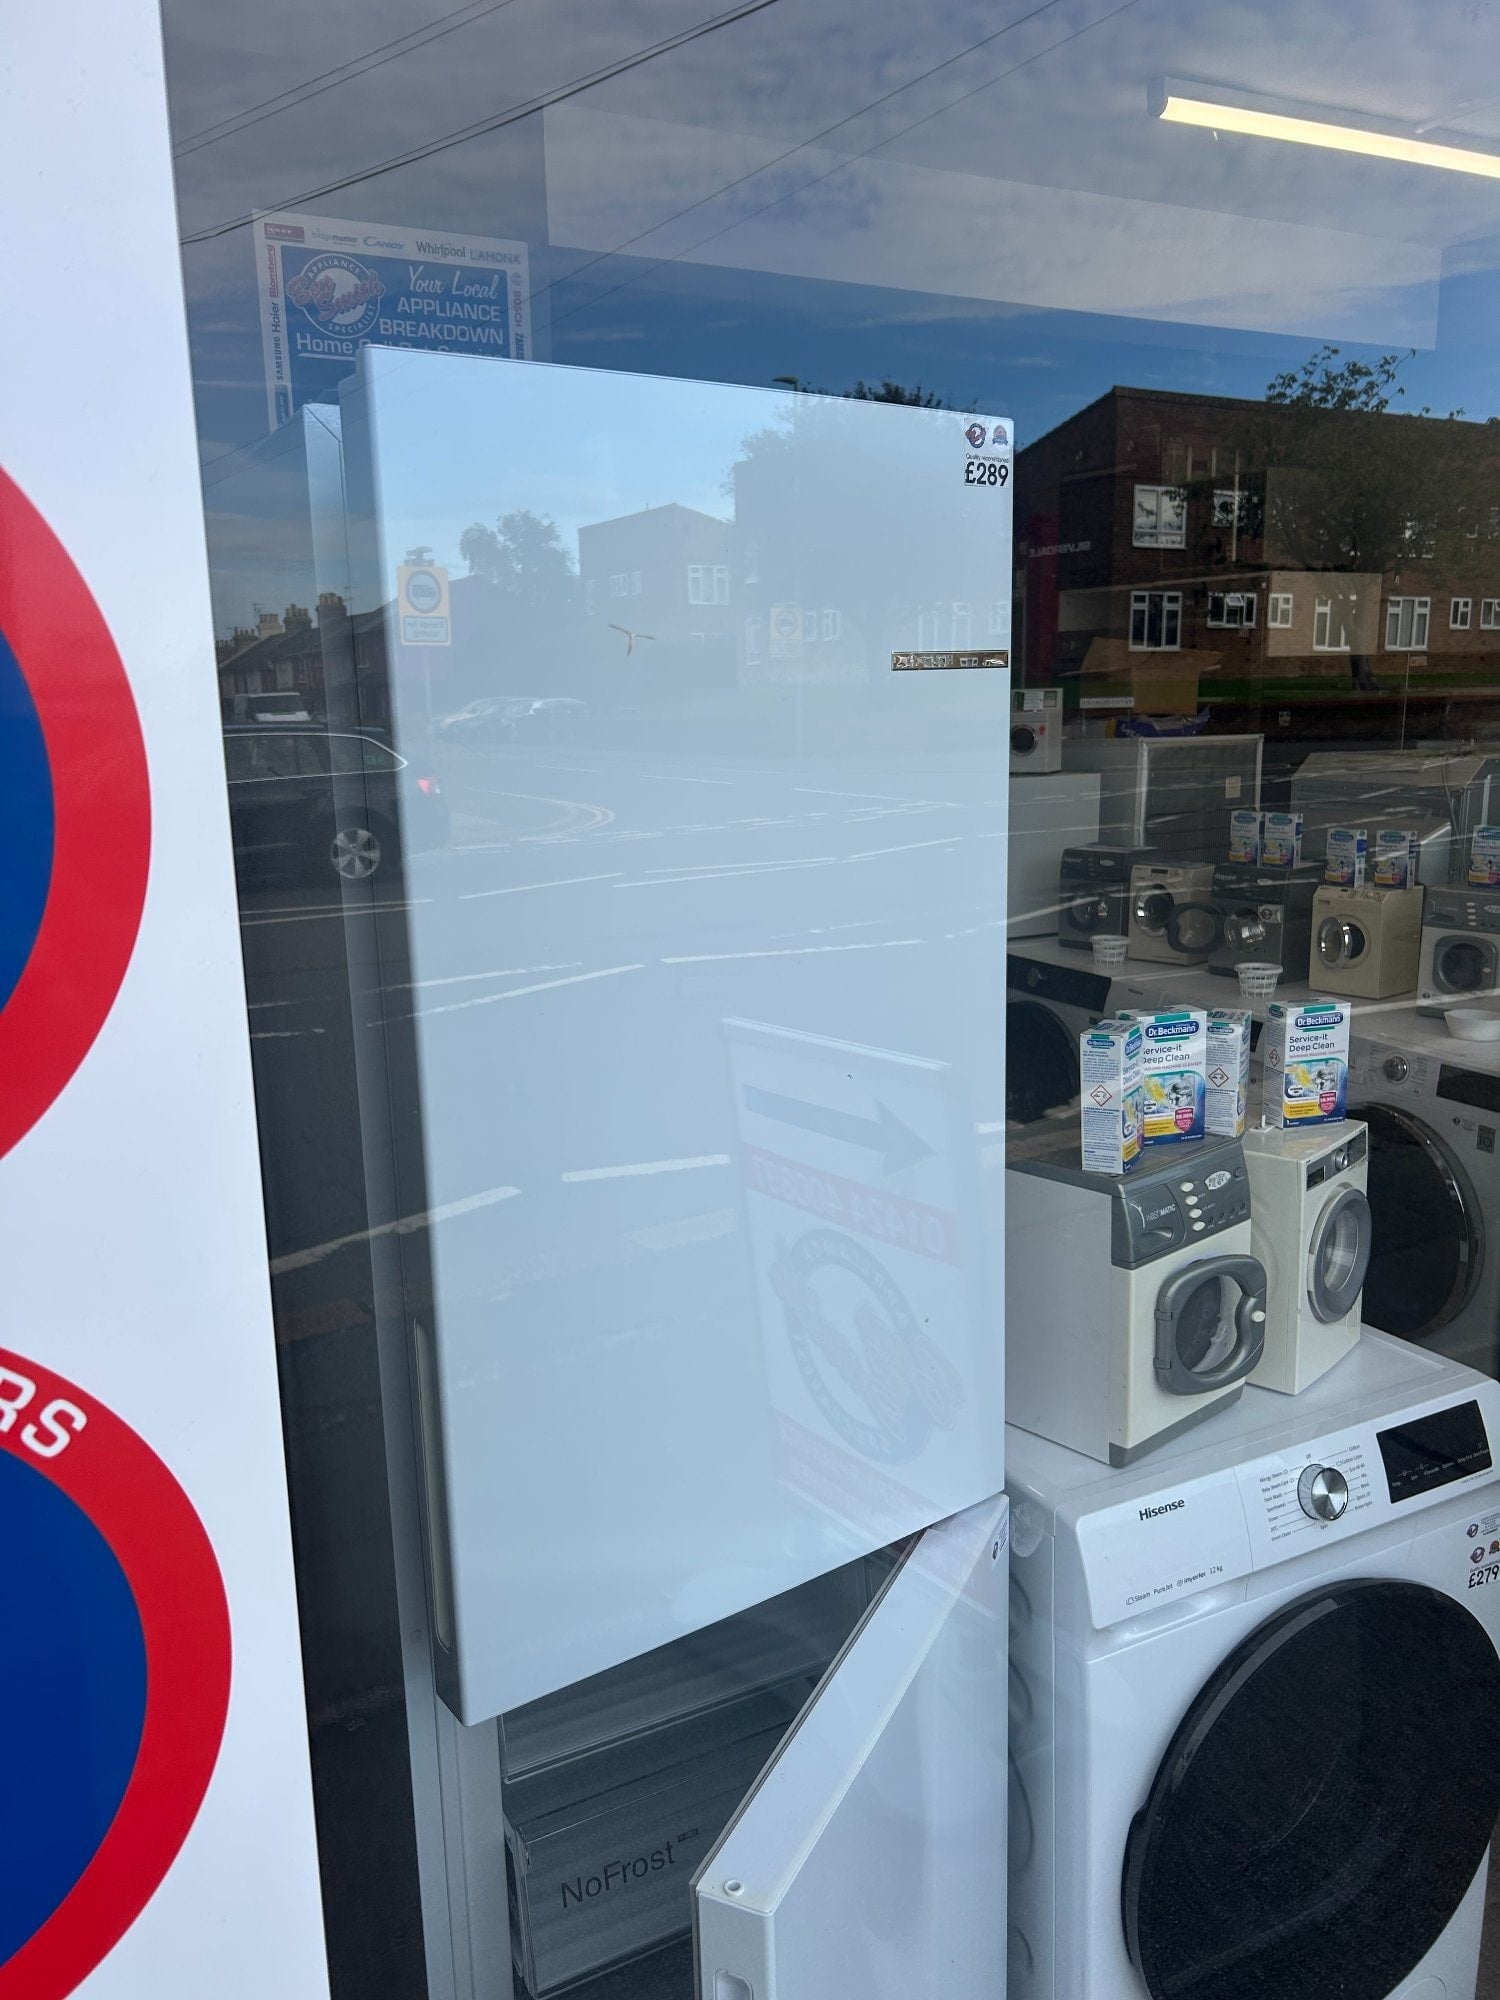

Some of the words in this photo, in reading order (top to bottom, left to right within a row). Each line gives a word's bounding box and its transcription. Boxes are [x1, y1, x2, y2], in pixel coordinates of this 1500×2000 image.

[415, 240, 466, 259] Whirlpool
[470, 250, 520, 265] LAMONA
[308, 258, 361, 279] APPLIANCE
[408, 265, 443, 294] Your
[452, 270, 499, 300] Local
[271, 301, 281, 333] Haier
[397, 297, 501, 322] APPLIANCE
[513, 290, 523, 328] BOSCH
[296, 332, 353, 354] Home
[379, 318, 504, 344] BREAKDOWN
[274, 336, 284, 381] SAMSUNG
[965, 461, 1009, 487] £289
[1289, 1033, 1328, 1044] Service-it
[1289, 1044, 1311, 1053] Deep
[1312, 1041, 1335, 1050] Clean
[1165, 1053, 1190, 1062] Clean
[1139, 1499, 1185, 1521] Hisense
[1468, 1564, 1500, 1589] £279
[1134, 1591, 1151, 1602] Steam
[560, 1840, 676, 1908] NoFrost
